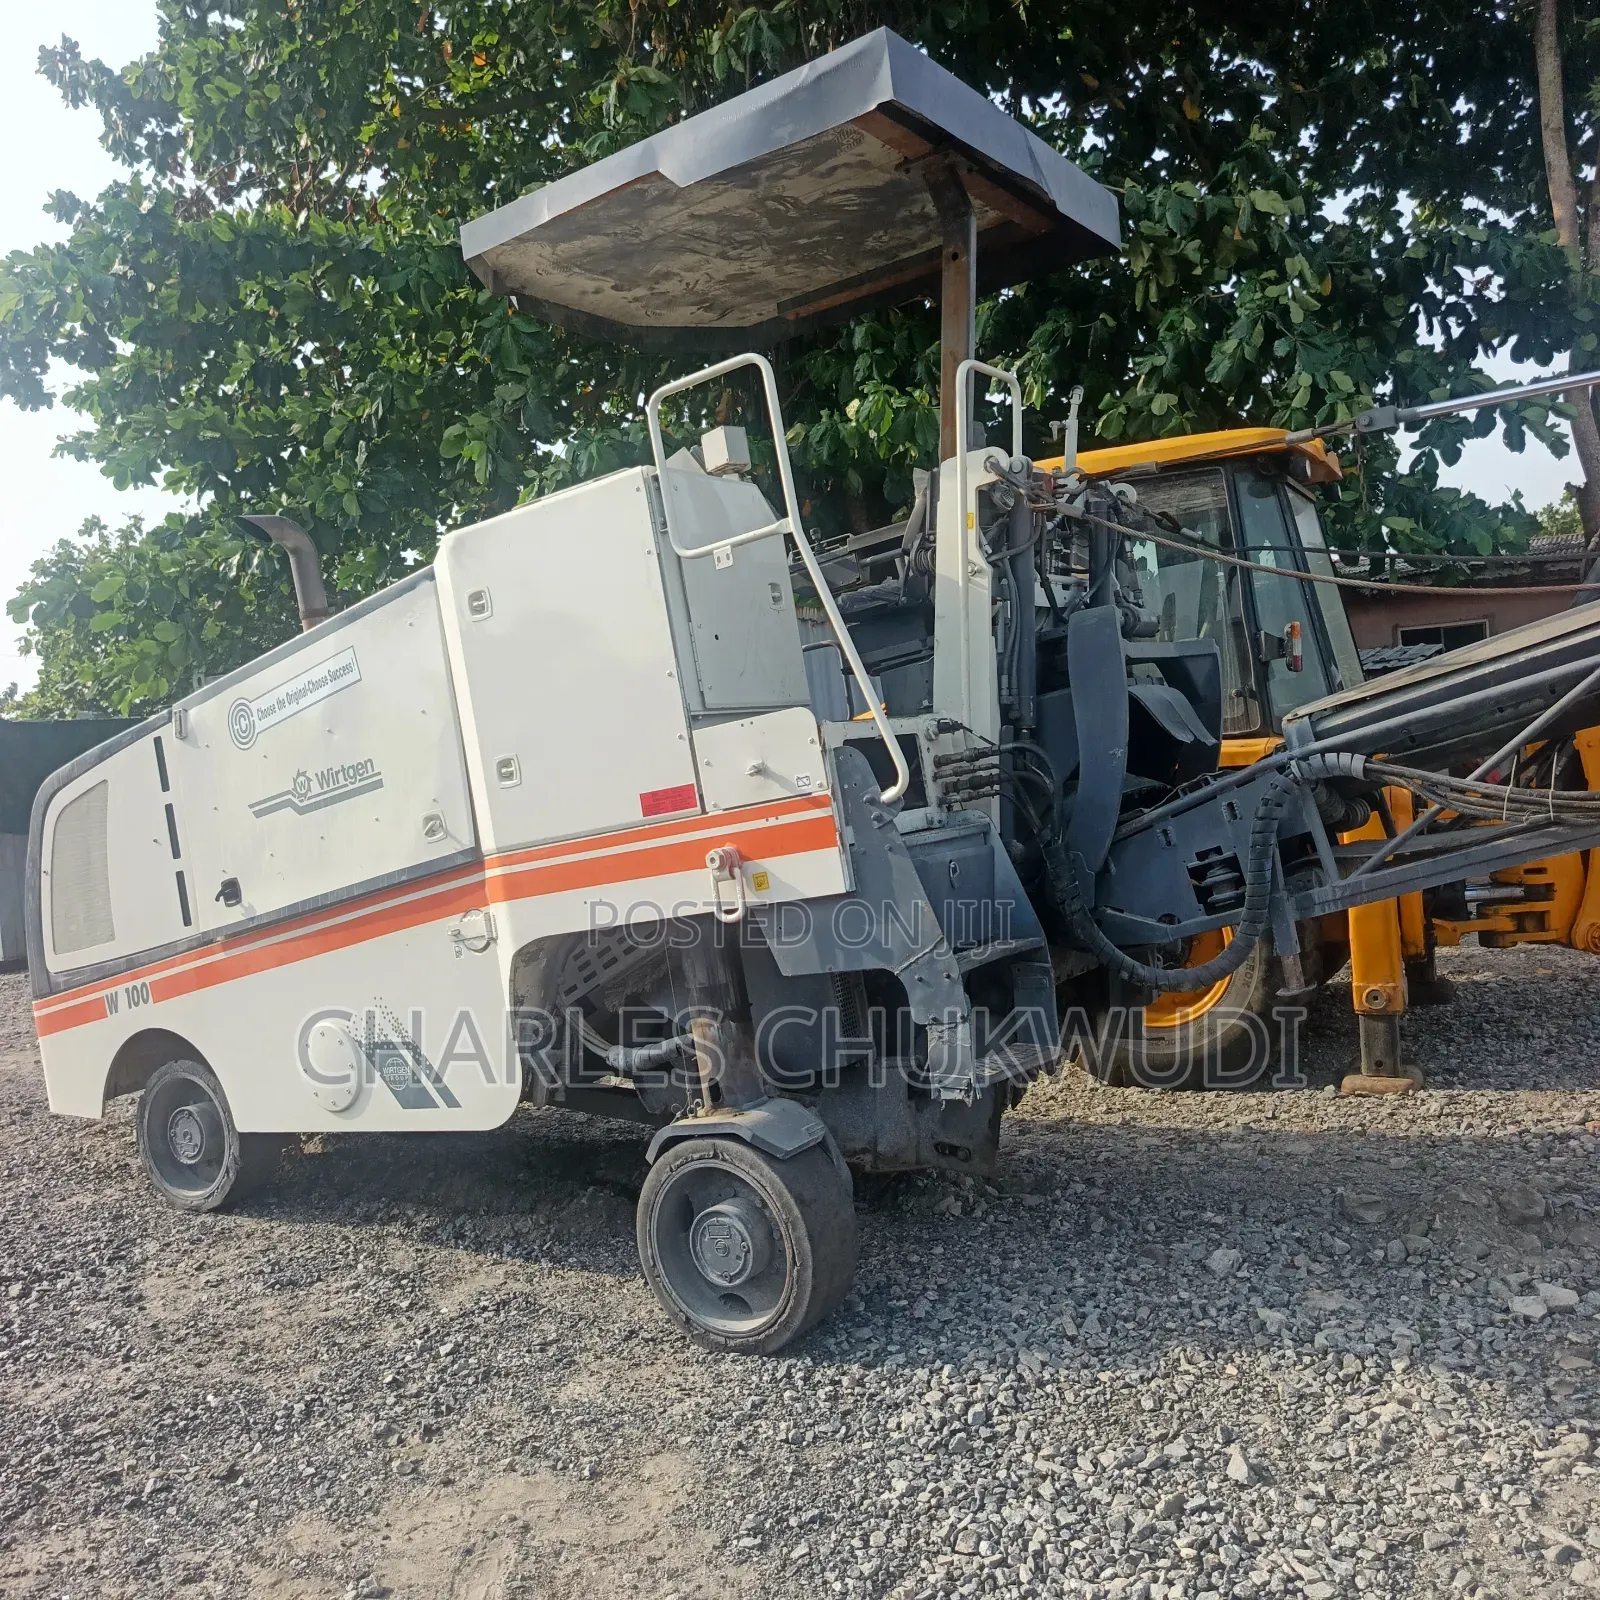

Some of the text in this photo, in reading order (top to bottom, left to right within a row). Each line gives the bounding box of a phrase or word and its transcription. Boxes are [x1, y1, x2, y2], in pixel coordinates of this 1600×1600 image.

[257, 704, 276, 721] Choose
[275, 696, 287, 711] the
[327, 658, 356, 683] Success!
[314, 757, 375, 791] Wirtgen
[105, 981, 150, 1016] W 100
[383, 1066, 410, 1074] WIRTGEN
